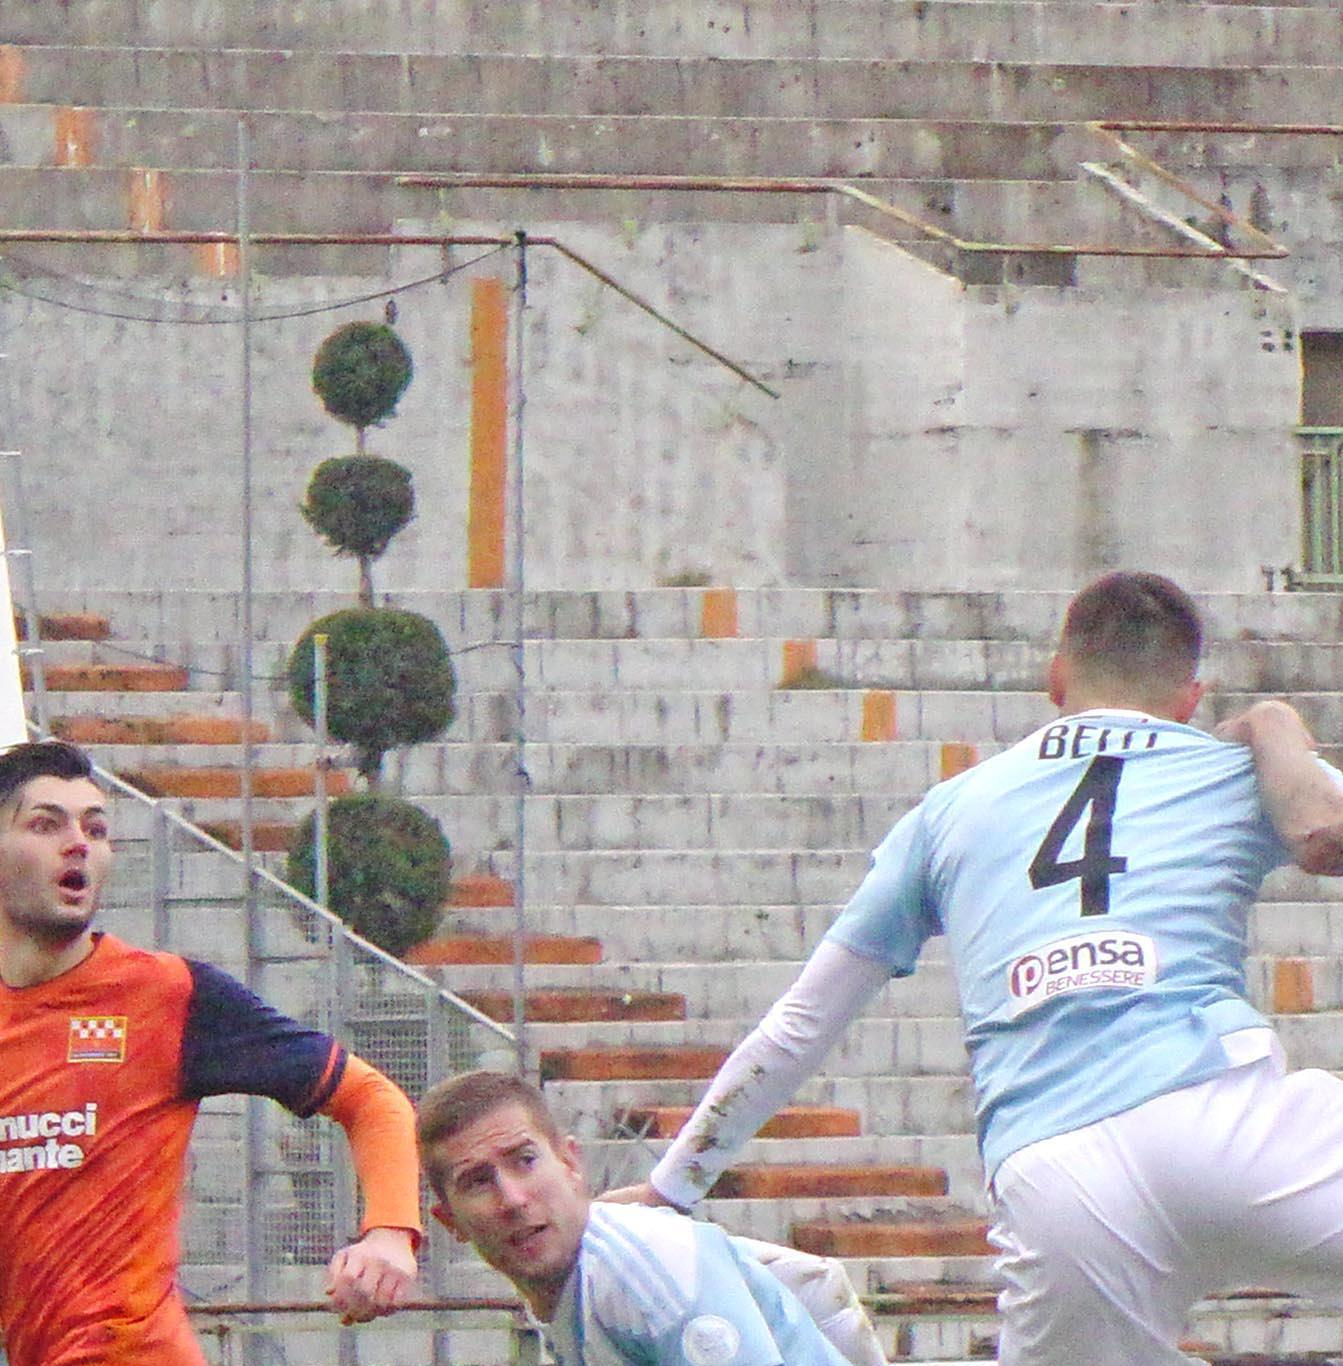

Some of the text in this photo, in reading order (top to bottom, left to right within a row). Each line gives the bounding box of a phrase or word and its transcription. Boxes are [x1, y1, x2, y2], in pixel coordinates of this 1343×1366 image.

[1027, 754, 1129, 917] 4
[1010, 938, 1146, 998] pensa
[1044, 968, 1146, 996] BENESSERE
